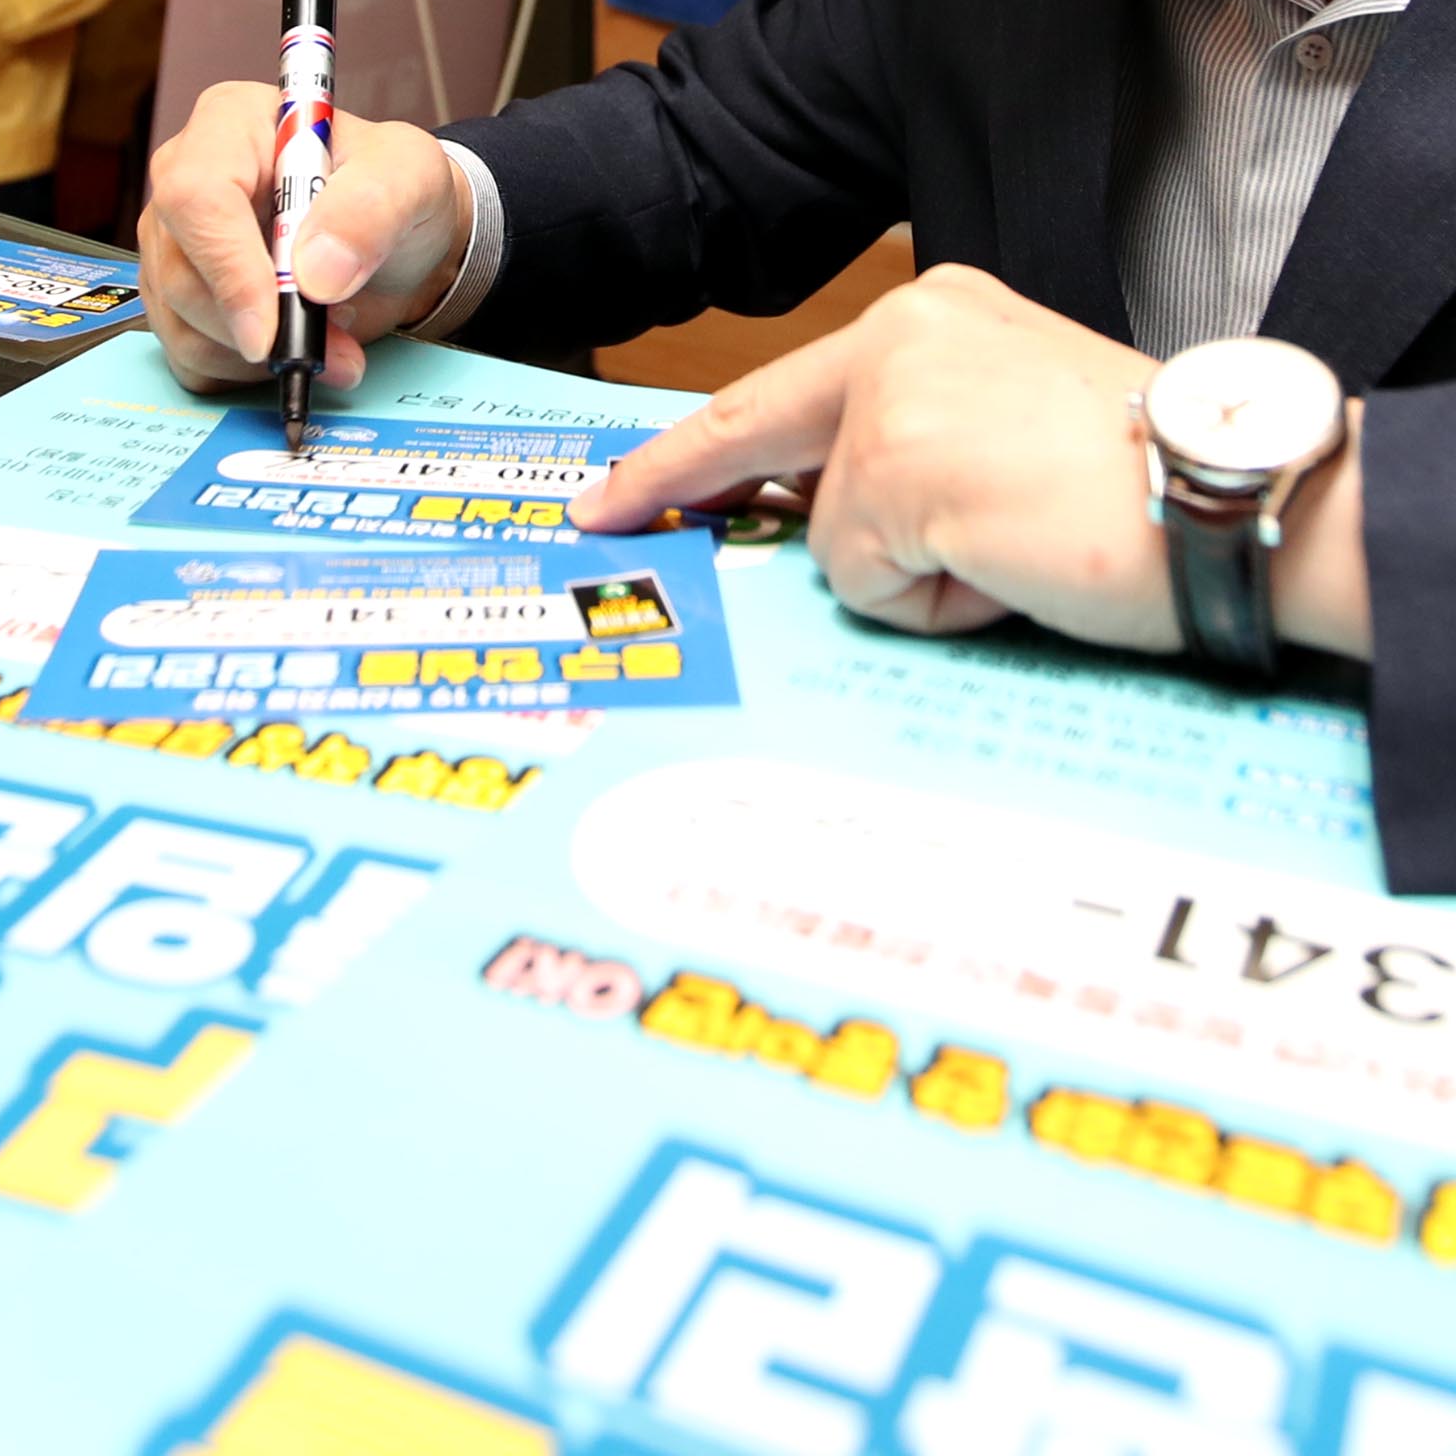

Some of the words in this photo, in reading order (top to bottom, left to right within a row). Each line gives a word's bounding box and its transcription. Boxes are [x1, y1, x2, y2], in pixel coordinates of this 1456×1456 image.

[397, 392, 464, 410] 동구
[194, 484, 401, 518] 출입관리
[410, 495, 568, 528] 안심콜
[89, 651, 341, 689] 출입관리
[358, 648, 544, 686] 안심콜
[560, 644, 680, 682] 동구
[229, 721, 371, 785] 작성
[477, 932, 645, 1022] OK!
[636, 972, 903, 1105] 통이면
